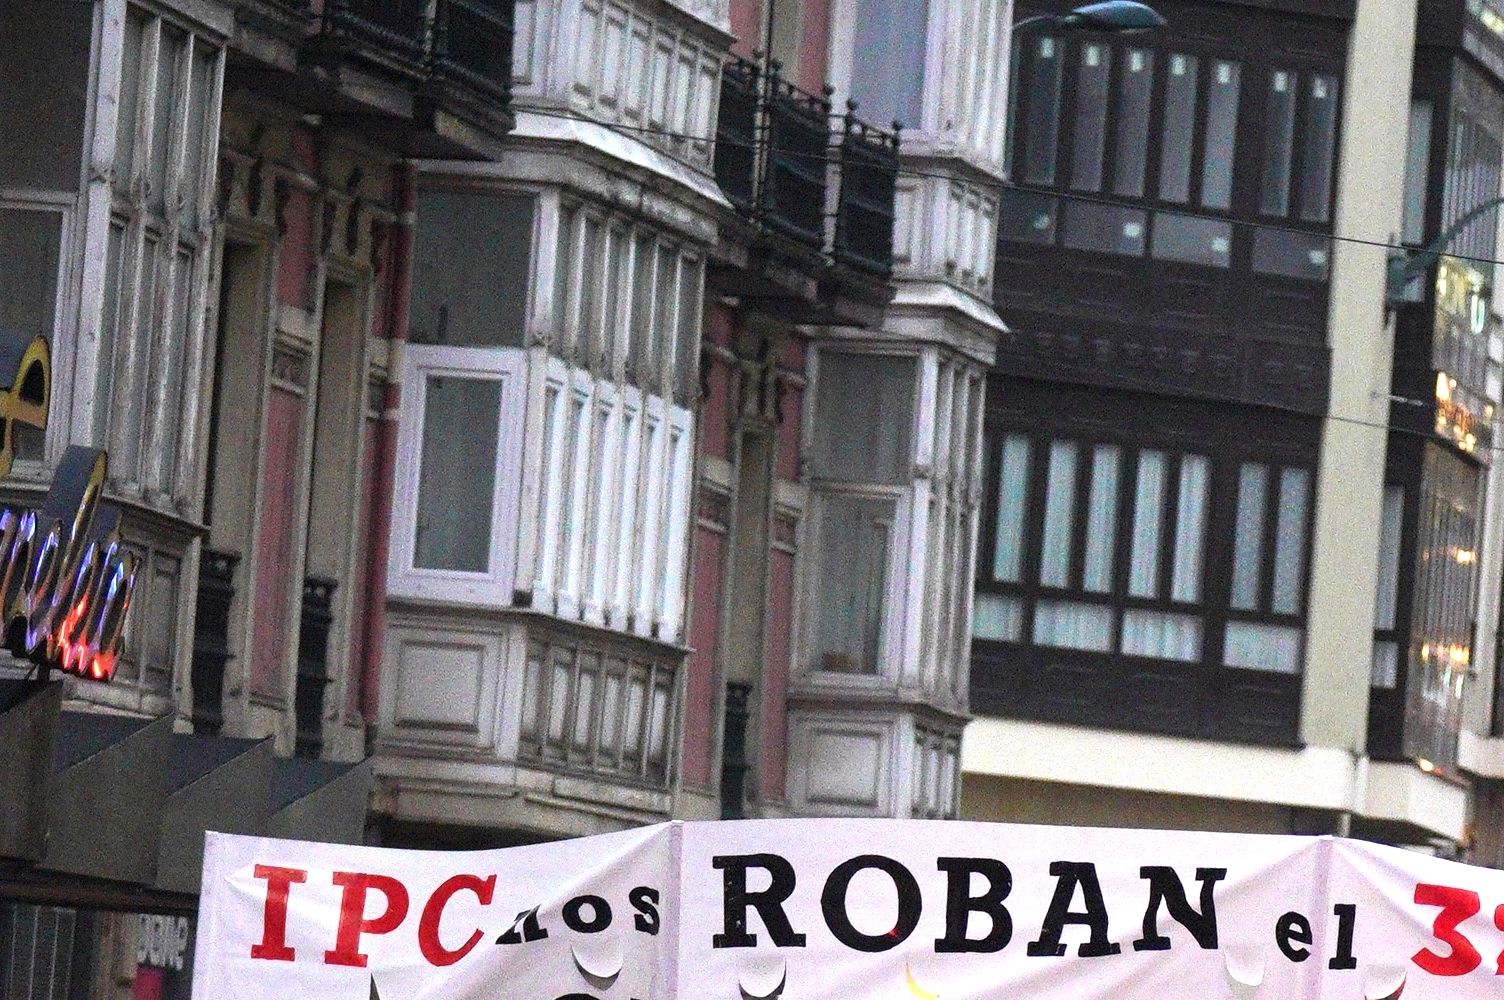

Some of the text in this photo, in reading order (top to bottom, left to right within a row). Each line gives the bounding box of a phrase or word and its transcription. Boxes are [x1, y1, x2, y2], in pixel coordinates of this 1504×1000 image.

[250, 863, 497, 968] IPC
[711, 852, 1226, 958] ROBAN
[1275, 904, 1357, 970] el
